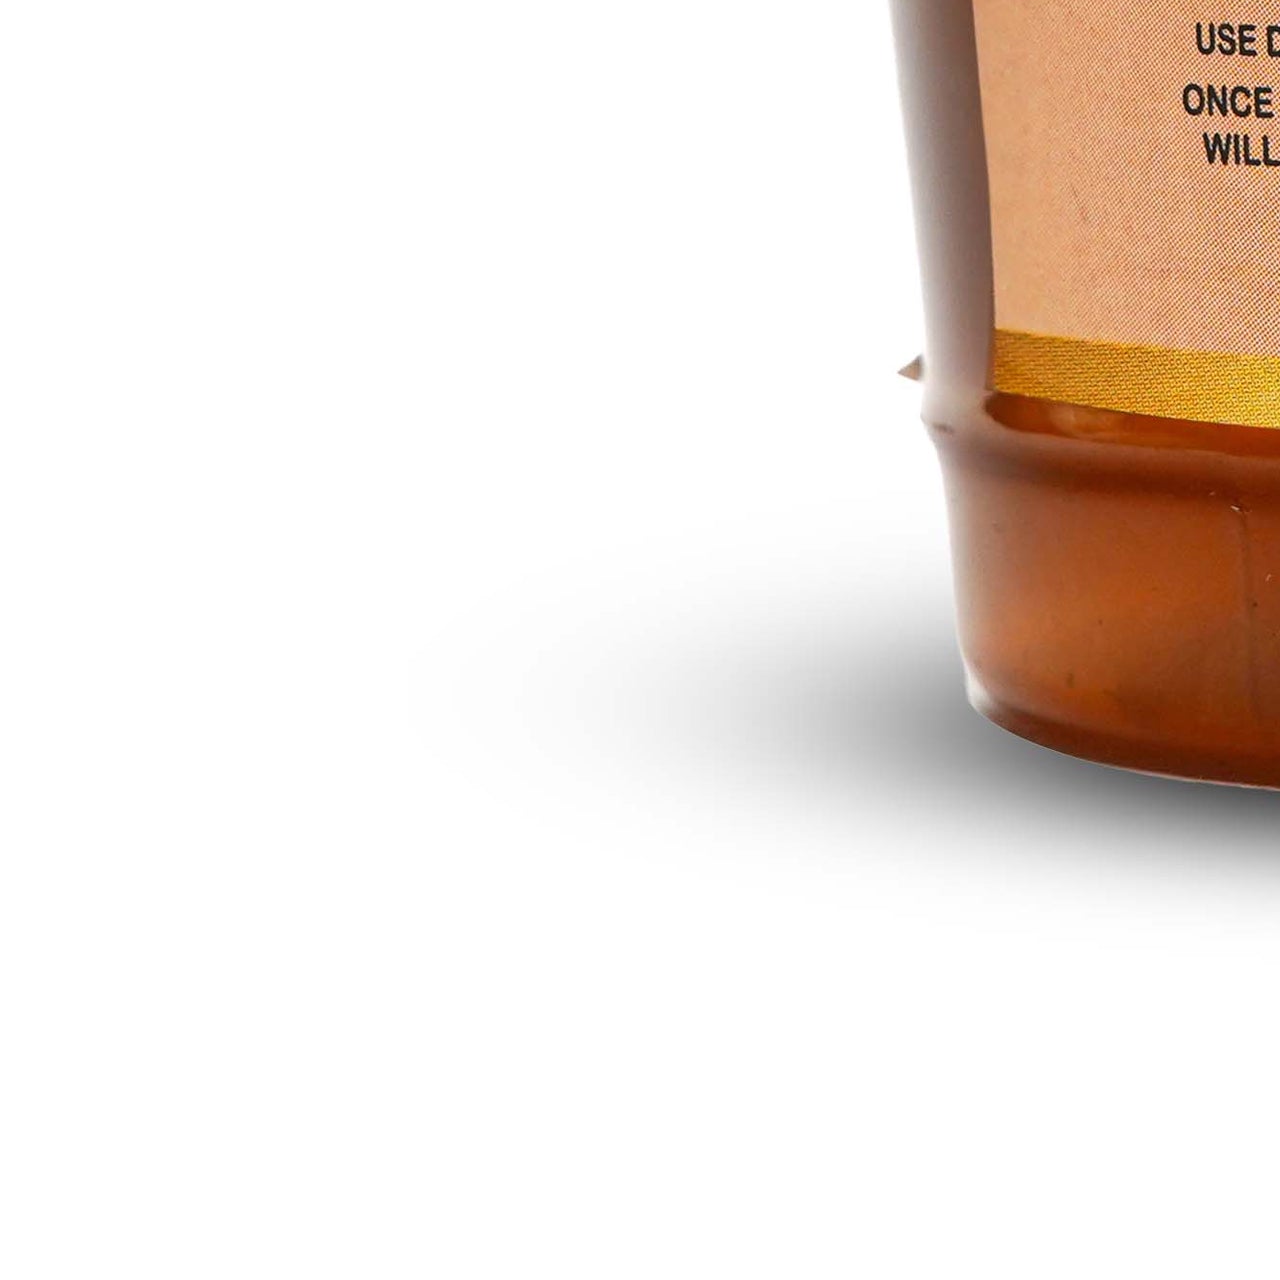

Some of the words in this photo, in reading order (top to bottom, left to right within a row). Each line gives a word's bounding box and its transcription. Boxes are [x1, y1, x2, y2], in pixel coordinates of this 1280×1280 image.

[1196, 23, 1257, 56] USE
[1183, 83, 1273, 119] ONCE
[1203, 133, 1280, 166] WILL
